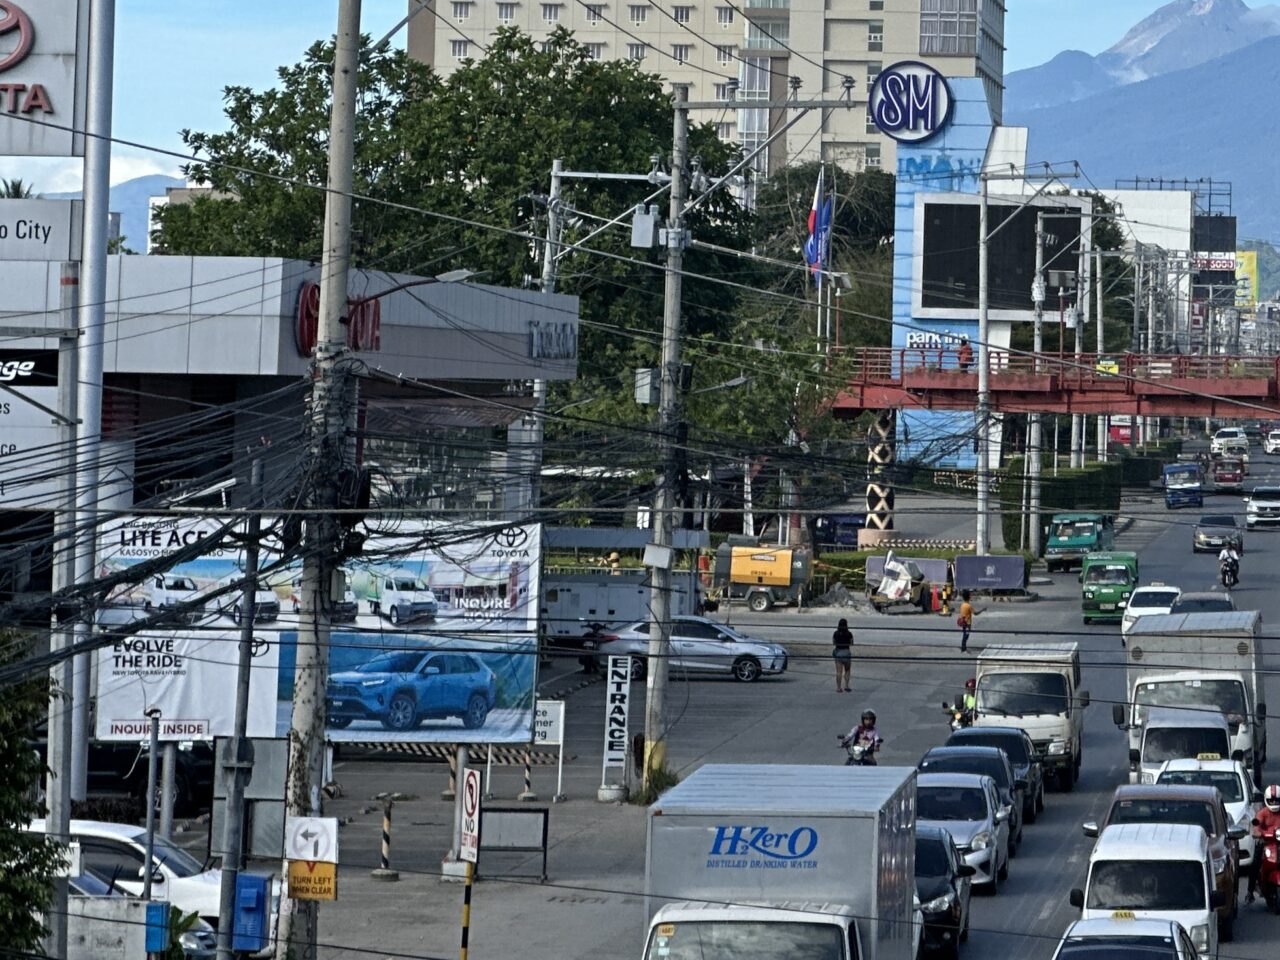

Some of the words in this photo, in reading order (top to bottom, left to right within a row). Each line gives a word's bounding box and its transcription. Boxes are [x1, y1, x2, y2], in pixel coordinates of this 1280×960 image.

[877, 71, 938, 132] SM
[16, 219, 52, 244] City
[906, 329, 942, 348] park
[120, 530, 162, 547] LITE
[490, 549, 530, 558] TOYOTA
[454, 597, 512, 609] INQUIRE
[113, 639, 175, 653] EVOLVE
[113, 655, 143, 668] THE
[146, 655, 183, 668] RIDE
[607, 658, 629, 752] ENTRANCE
[163, 724, 204, 735] INSIDE
[464, 818, 475, 833] NO
[706, 859, 748, 869] DISTILLED
[750, 860, 788, 869] DRINKING
[790, 860, 818, 869] WATER
[293, 876, 312, 885] TURN
[313, 876, 332, 885] LEFT
[292, 885, 310, 894] WHEN
[311, 886, 333, 895] CLEAR
